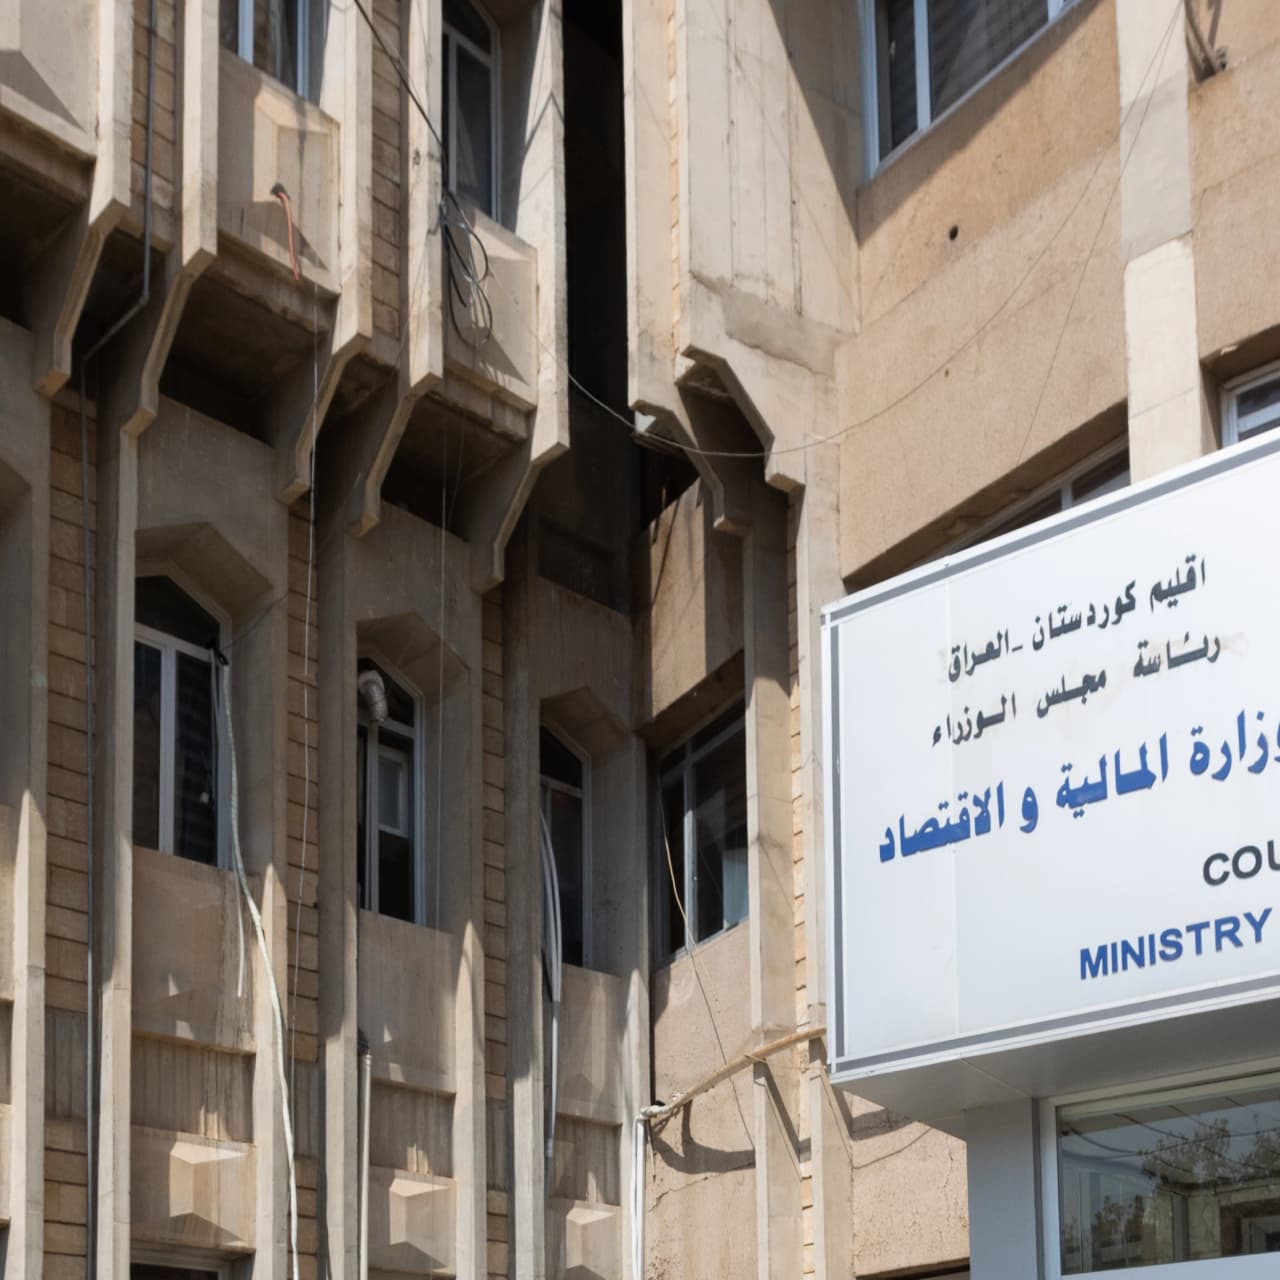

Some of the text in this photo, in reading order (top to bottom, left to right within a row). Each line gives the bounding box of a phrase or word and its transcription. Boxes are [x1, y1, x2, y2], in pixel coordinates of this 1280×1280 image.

[1031, 579, 1137, 652] كوردستان
[1149, 553, 1207, 614] اقليم
[931, 691, 1017, 748] الوزراء
[1036, 669, 1108, 719] مجلس
[1055, 731, 1170, 820] المالية
[878, 780, 1006, 865] الاقتصاد
[1019, 786, 1040, 835] و
[1079, 907, 1273, 981] MINISTRY
